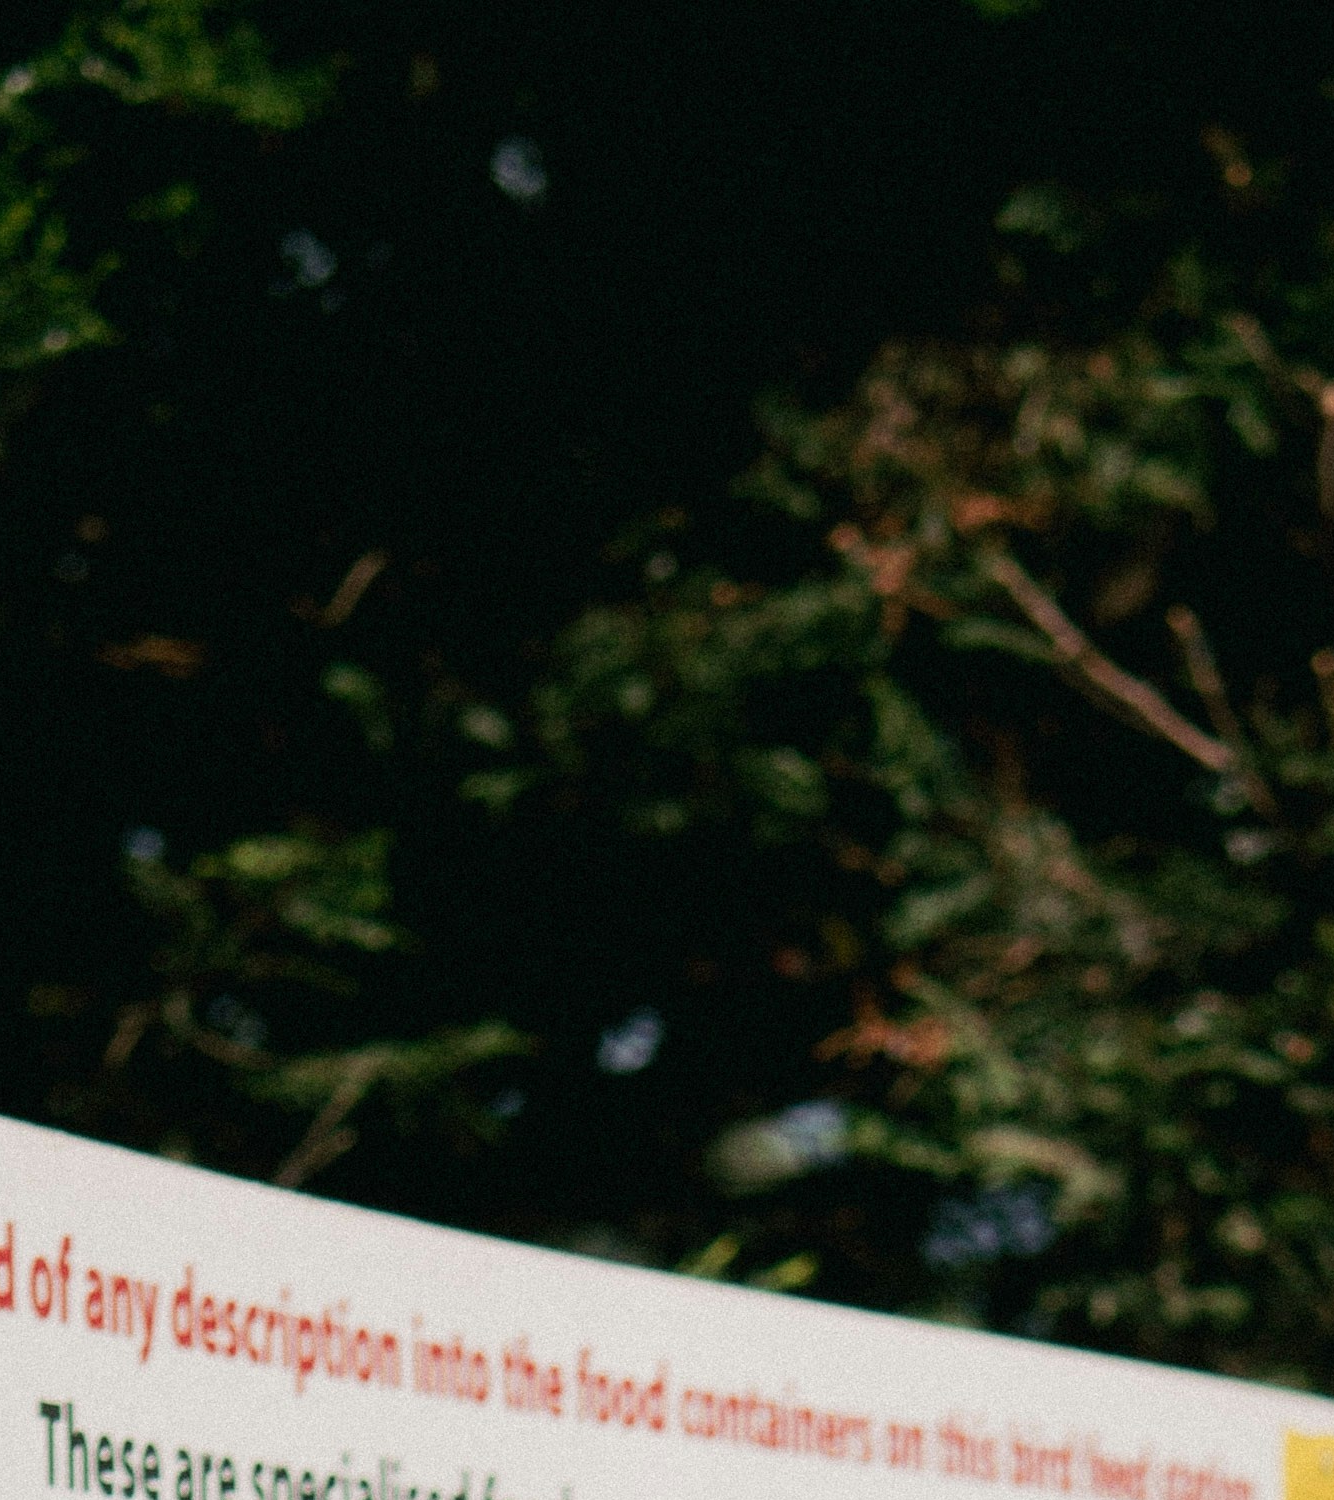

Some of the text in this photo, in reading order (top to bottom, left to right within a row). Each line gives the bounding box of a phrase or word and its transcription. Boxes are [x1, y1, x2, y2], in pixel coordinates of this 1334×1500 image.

[30, 1235, 72, 1322] of
[85, 1268, 158, 1363] any
[171, 1265, 402, 1394] description
[412, 1314, 489, 1404] into
[503, 1334, 565, 1416] the
[576, 1346, 667, 1431] food
[681, 1383, 872, 1466] containers
